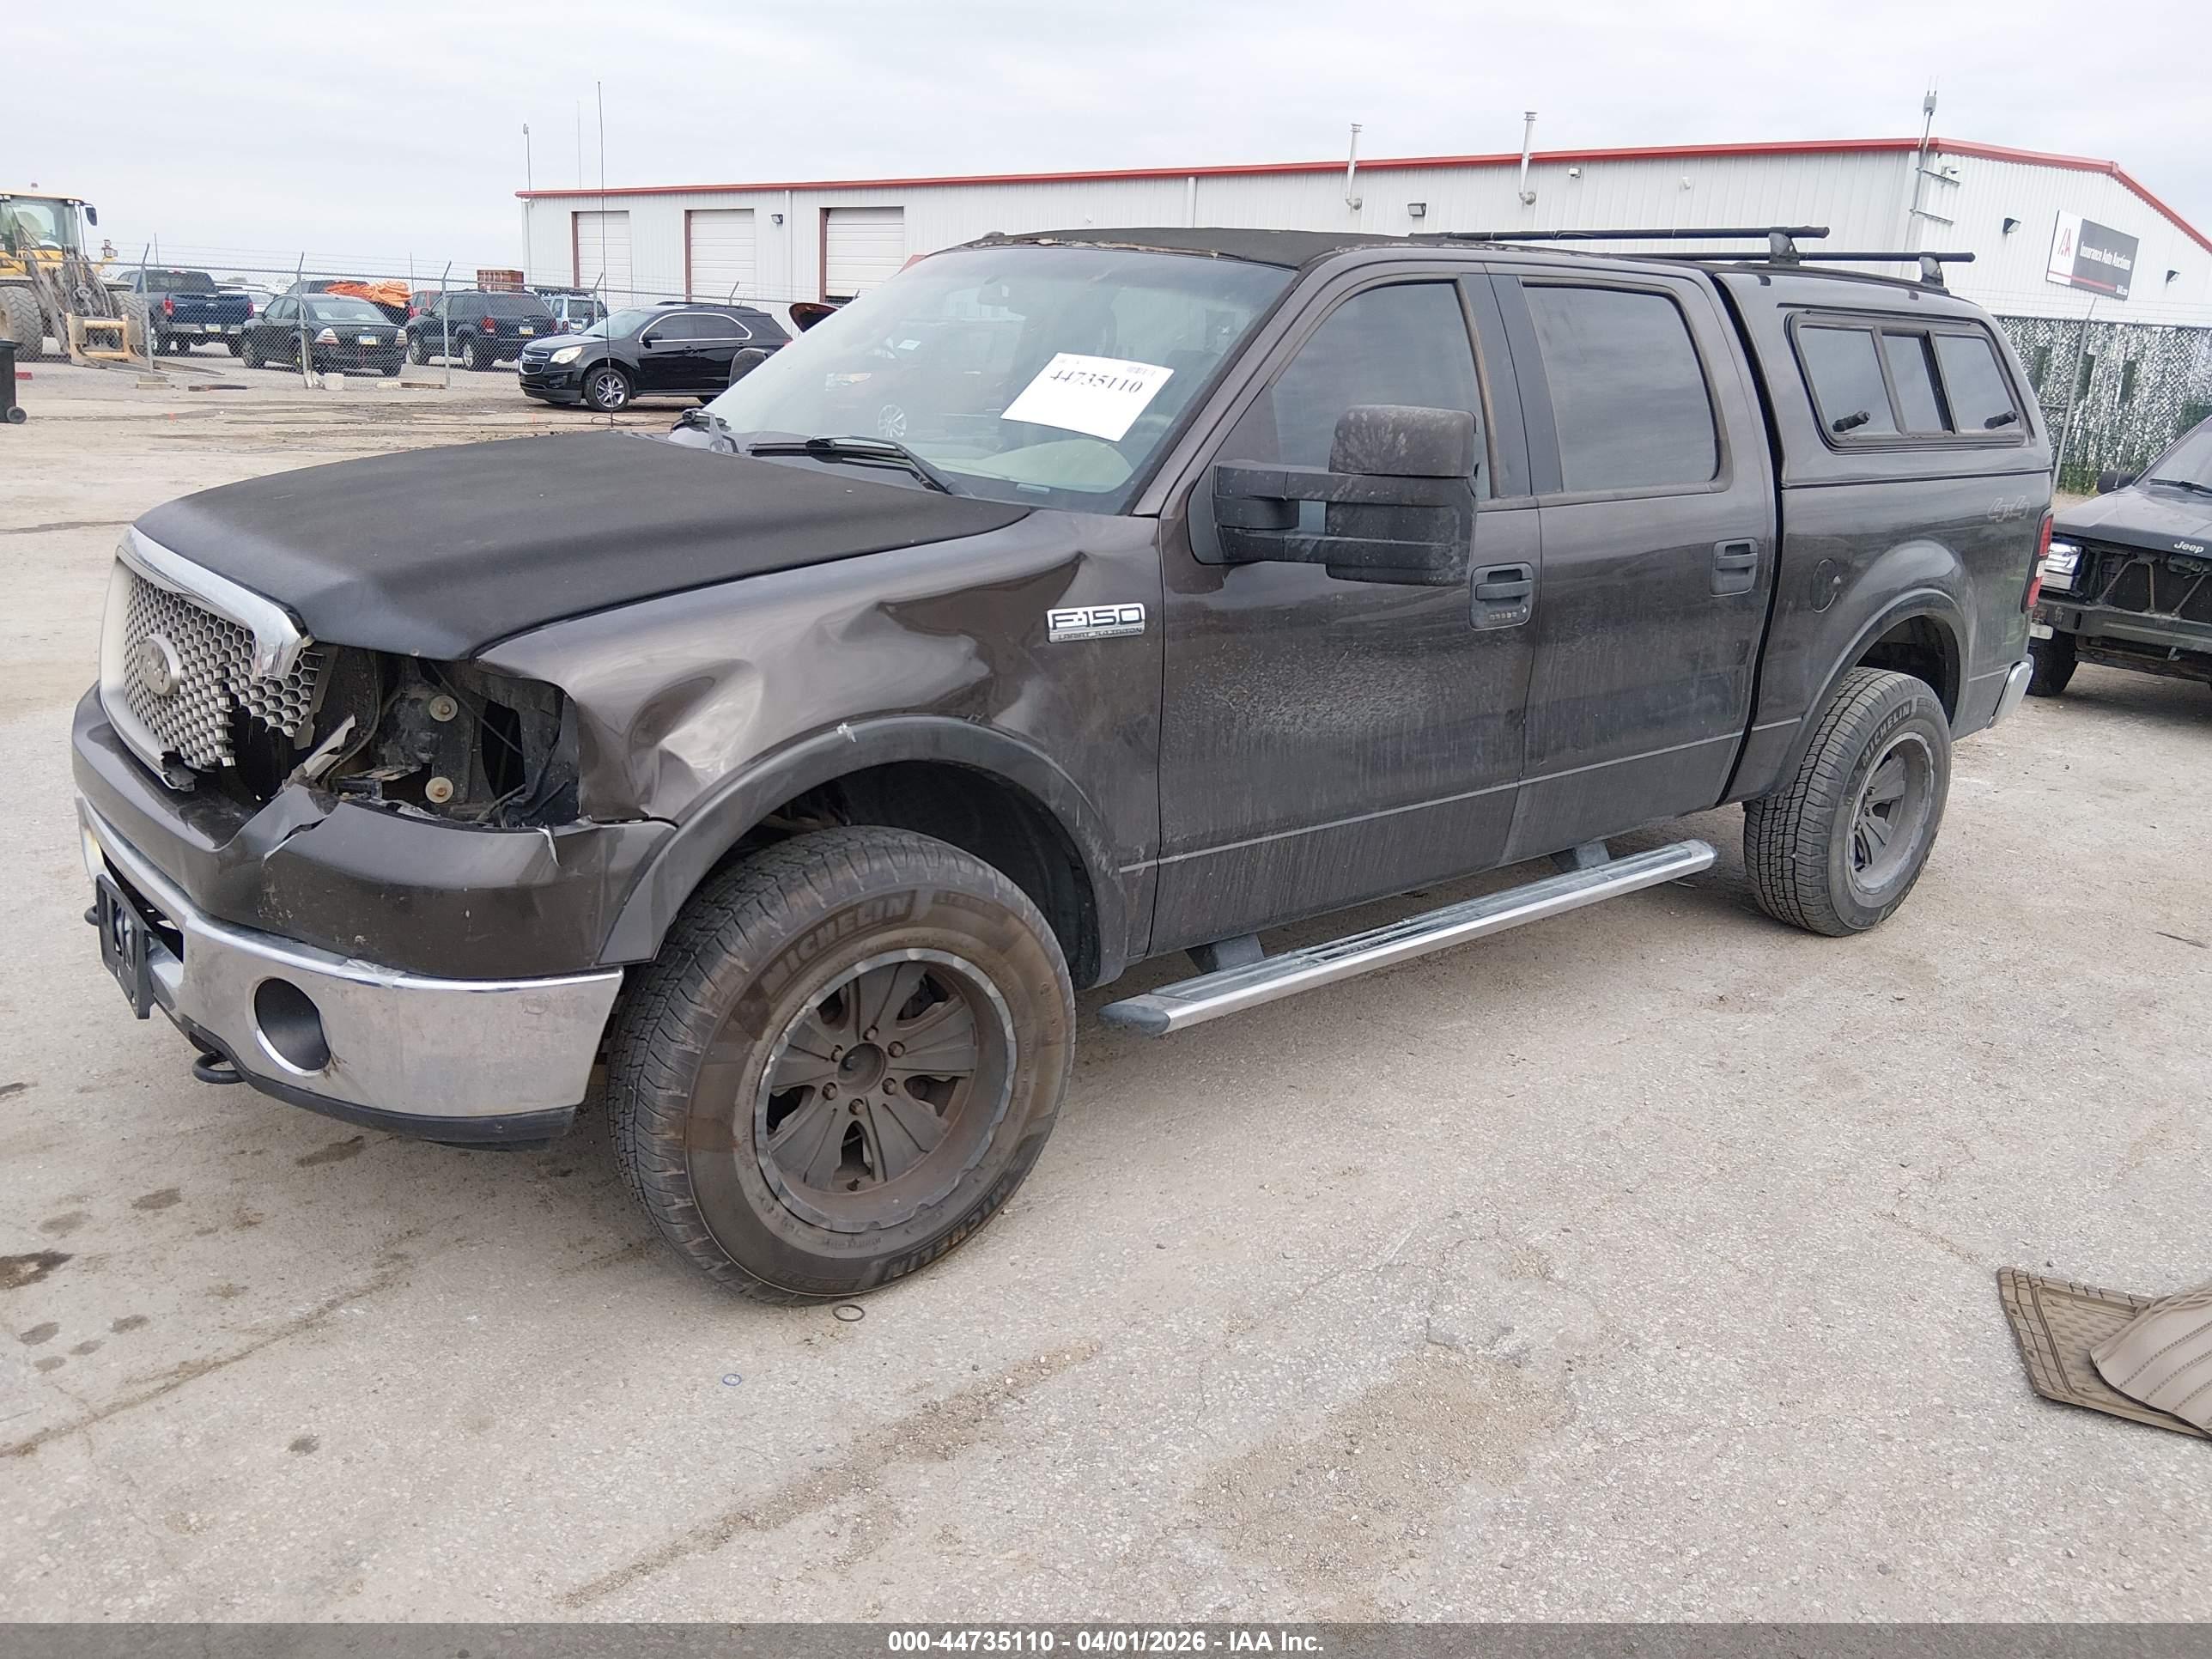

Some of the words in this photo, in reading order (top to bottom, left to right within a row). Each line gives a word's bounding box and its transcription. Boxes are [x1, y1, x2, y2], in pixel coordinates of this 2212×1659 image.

[2080, 241, 2103, 262] Insurance
[2101, 248, 2113, 265] Auto
[2112, 251, 2131, 270] Auctions
[1050, 370, 1143, 392] 44735110
[2173, 541, 2204, 554] Jeep
[1052, 606, 1144, 630] F-150
[1862, 702, 1911, 767] MICHELIN
[760, 893, 911, 995] MICHELIN
